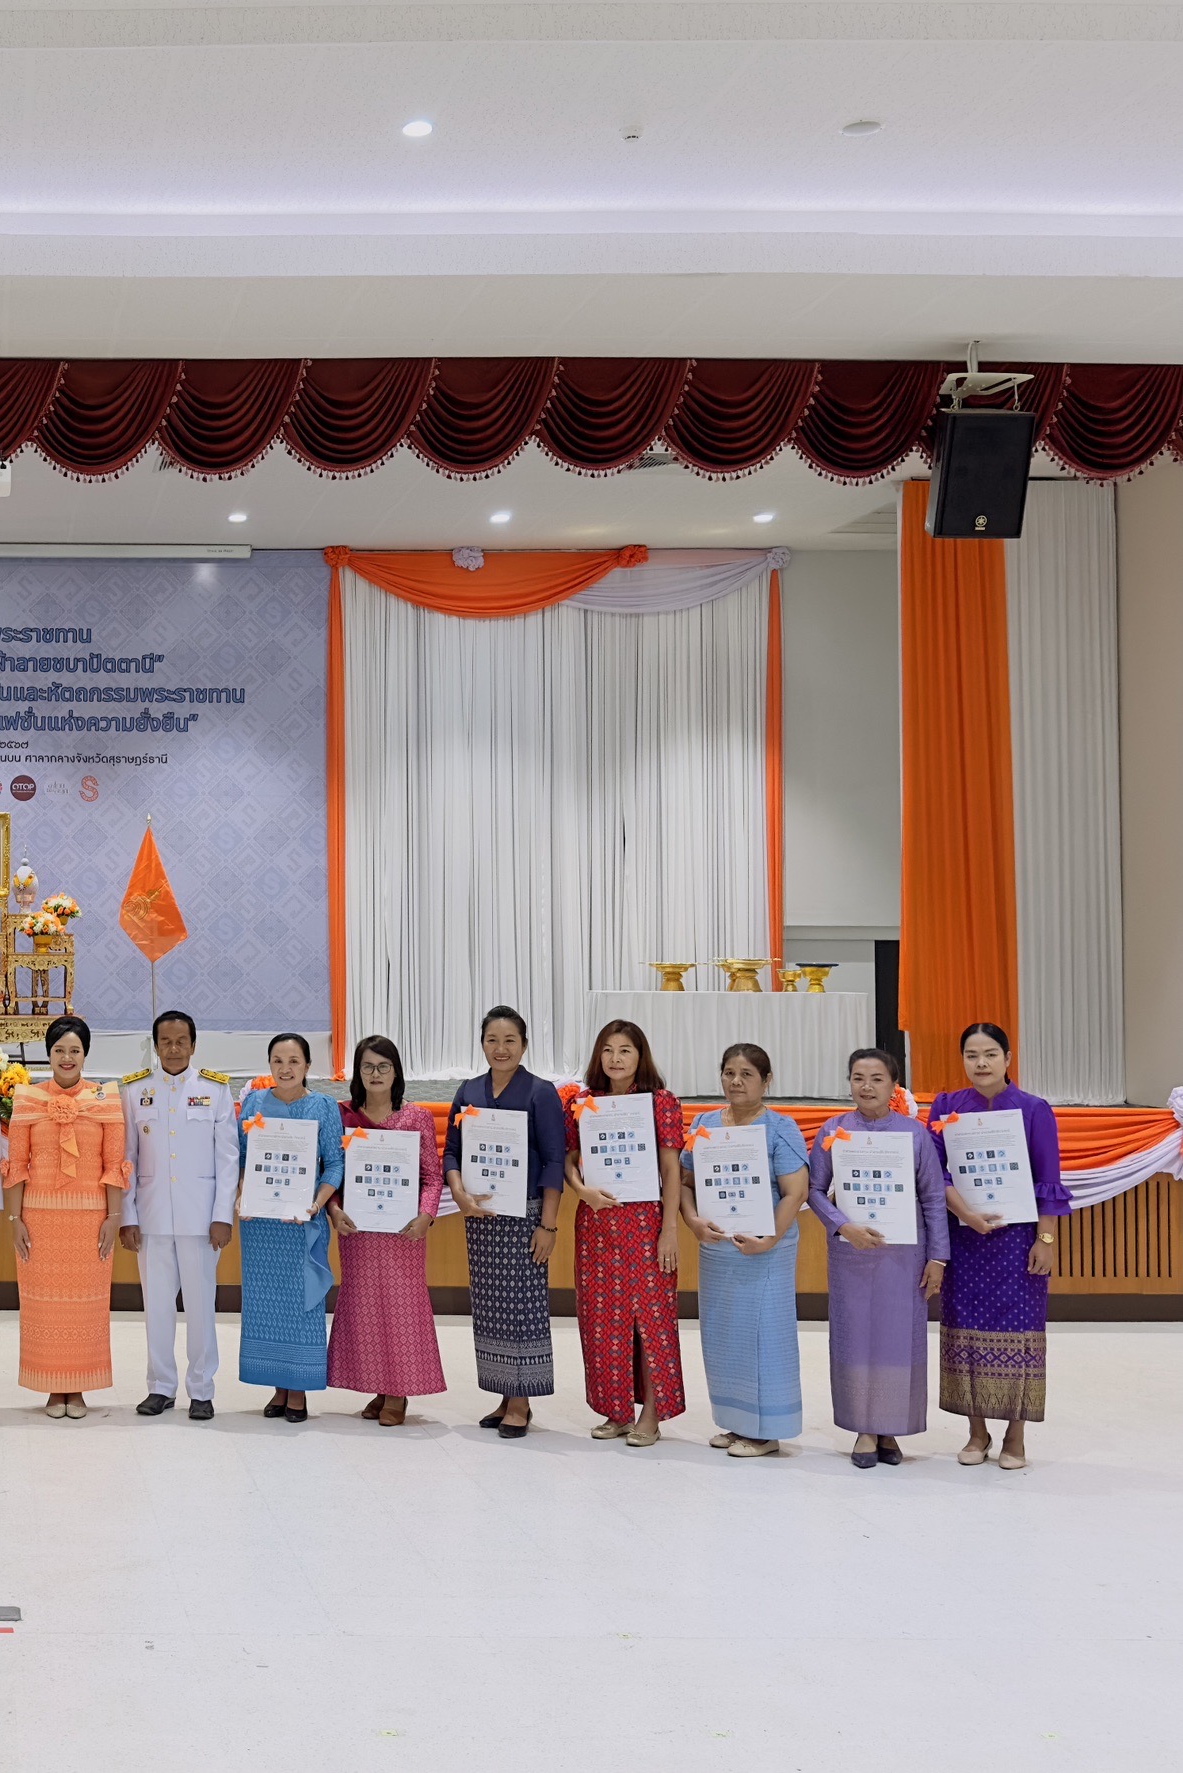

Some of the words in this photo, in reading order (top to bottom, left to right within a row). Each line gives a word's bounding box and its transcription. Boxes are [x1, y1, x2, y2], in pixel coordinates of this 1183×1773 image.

[25, 753, 168, 766] ศาลากลางจังหวัดสุราษฎร์ธานี
